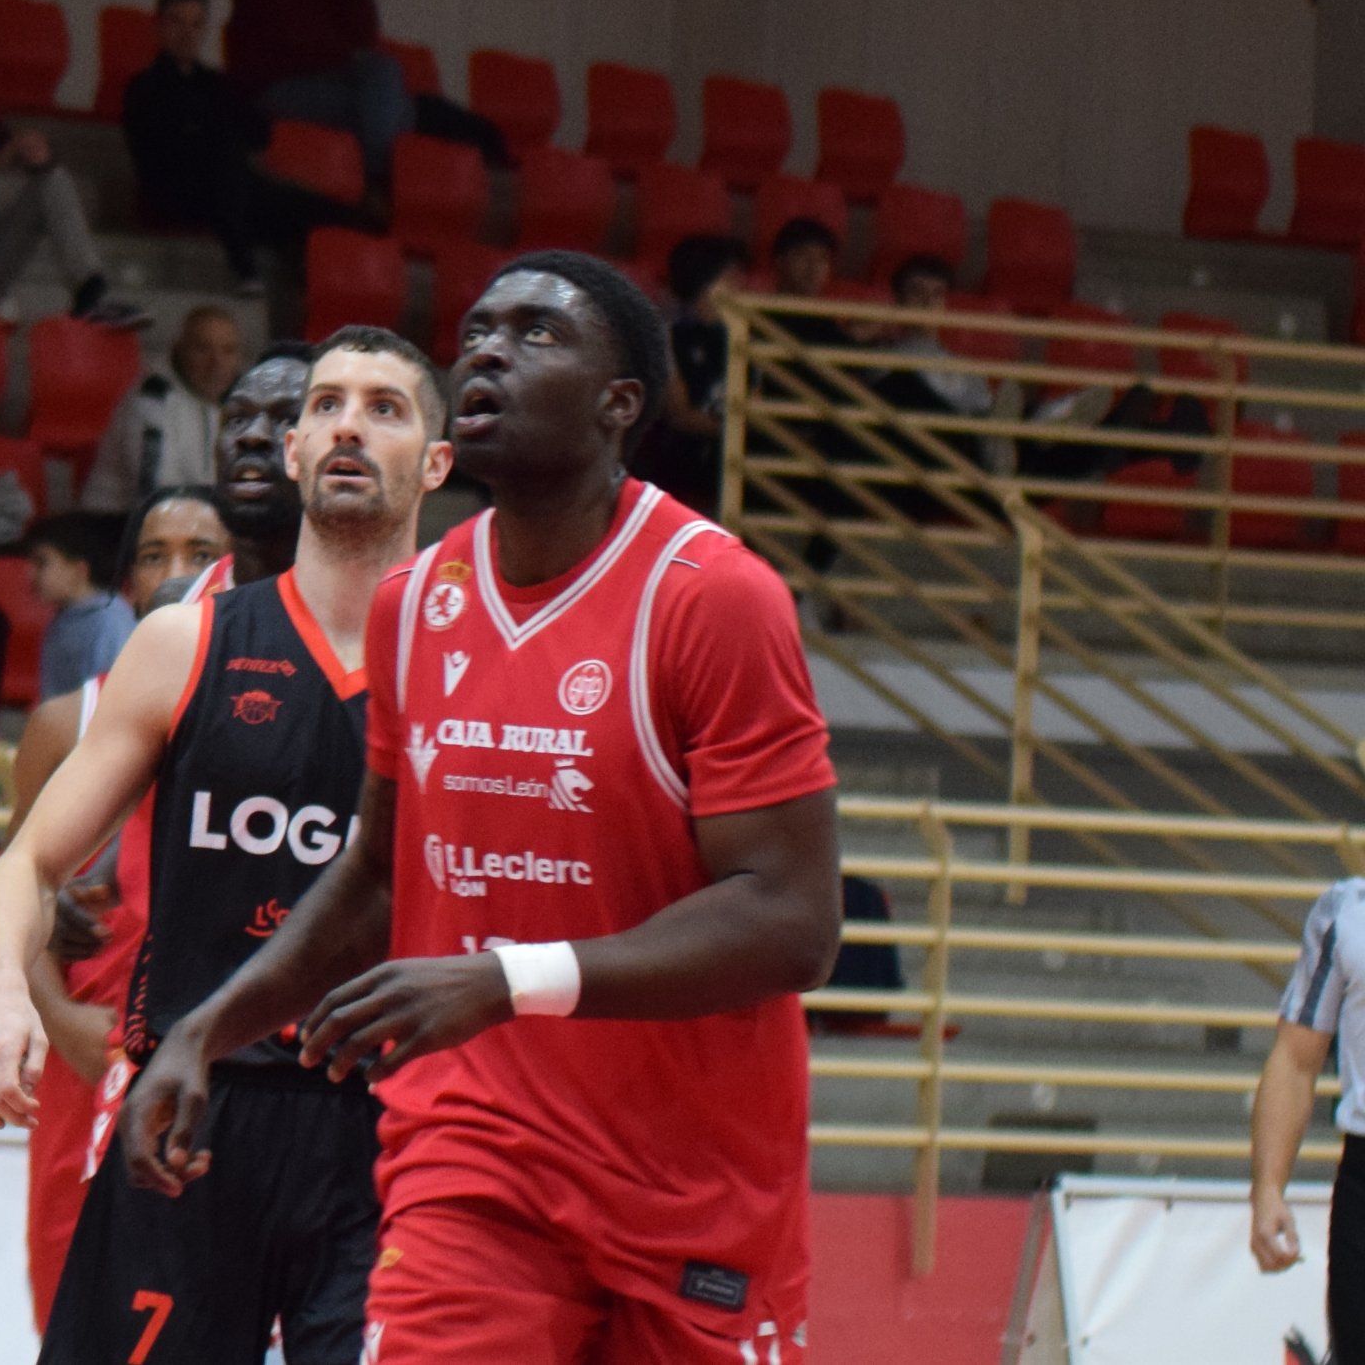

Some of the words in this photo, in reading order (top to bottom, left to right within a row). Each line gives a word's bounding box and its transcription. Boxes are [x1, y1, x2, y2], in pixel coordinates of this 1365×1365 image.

[437, 719, 496, 748] CAJA
[499, 724, 594, 757] RURAL
[127, 1290, 174, 1365] 7
